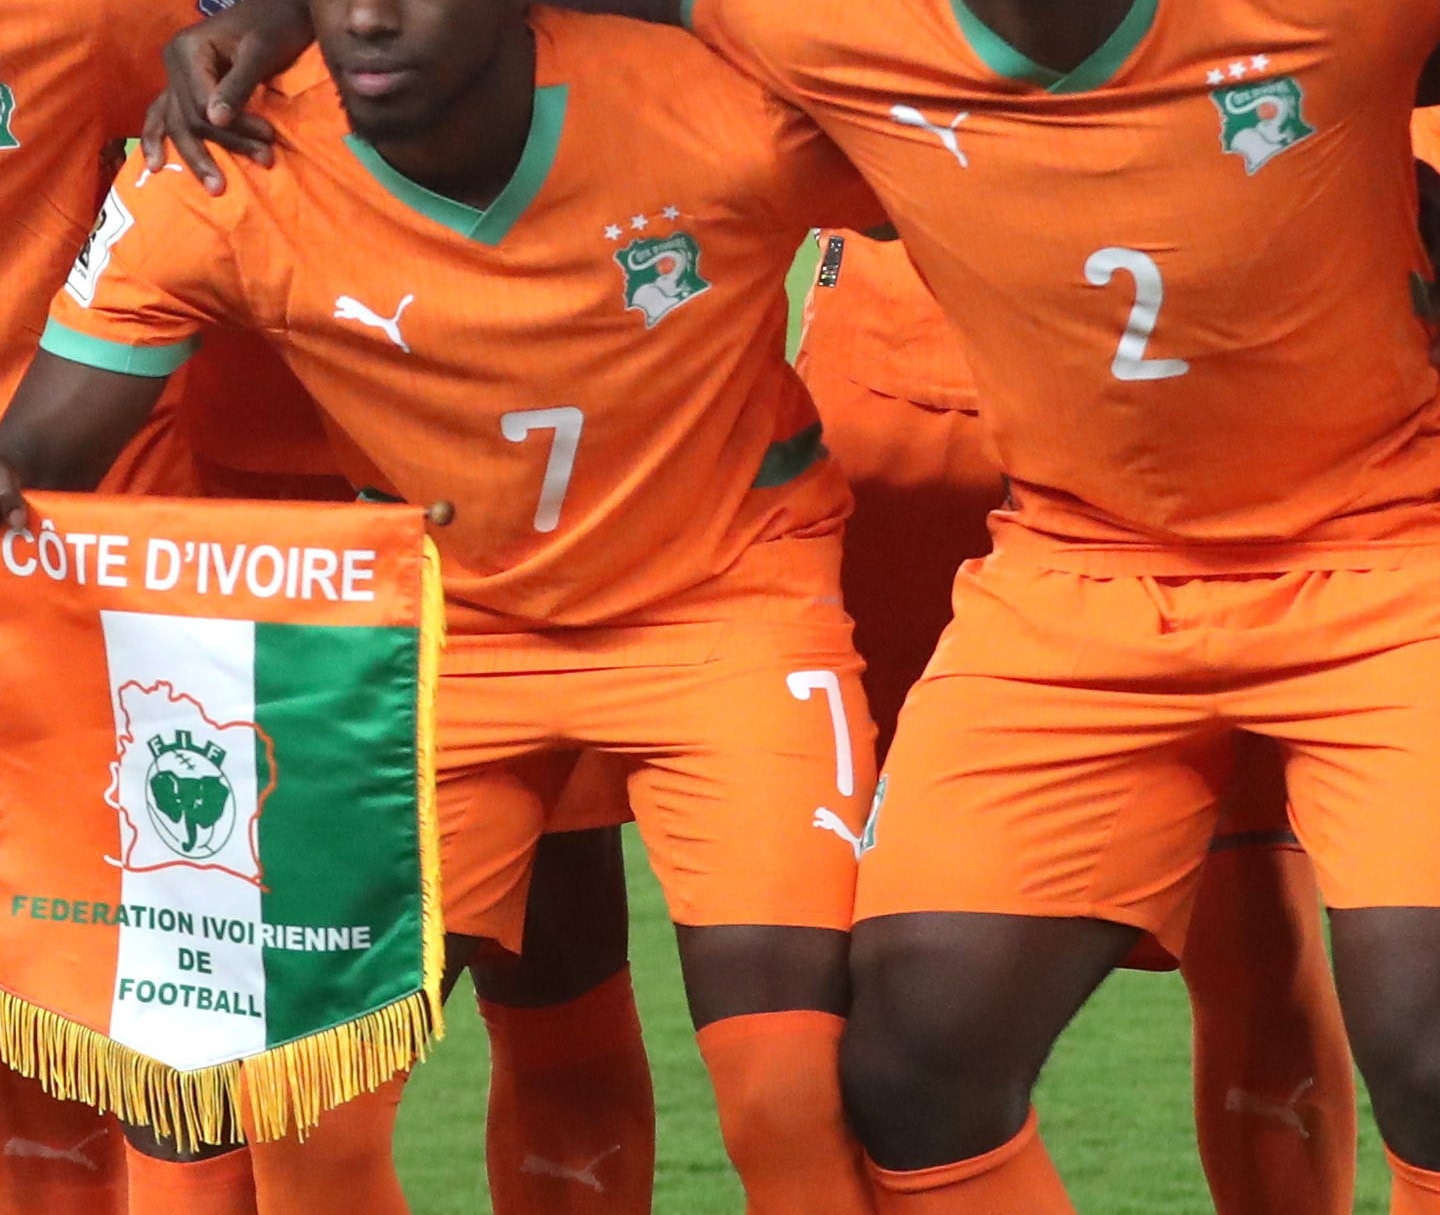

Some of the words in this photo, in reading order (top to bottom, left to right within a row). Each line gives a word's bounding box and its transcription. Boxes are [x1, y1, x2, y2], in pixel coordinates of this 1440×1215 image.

[1084, 247, 1190, 381] 2
[500, 406, 584, 533] 7
[1, 519, 129, 587] CÔTE
[145, 538, 376, 601] D'IVOIRE
[786, 670, 854, 797] 7
[11, 894, 195, 935] FEDERATION
[202, 916, 371, 952] IVOIRIENNE
[178, 947, 213, 975] DE
[117, 978, 263, 1018] FOOTBALL
